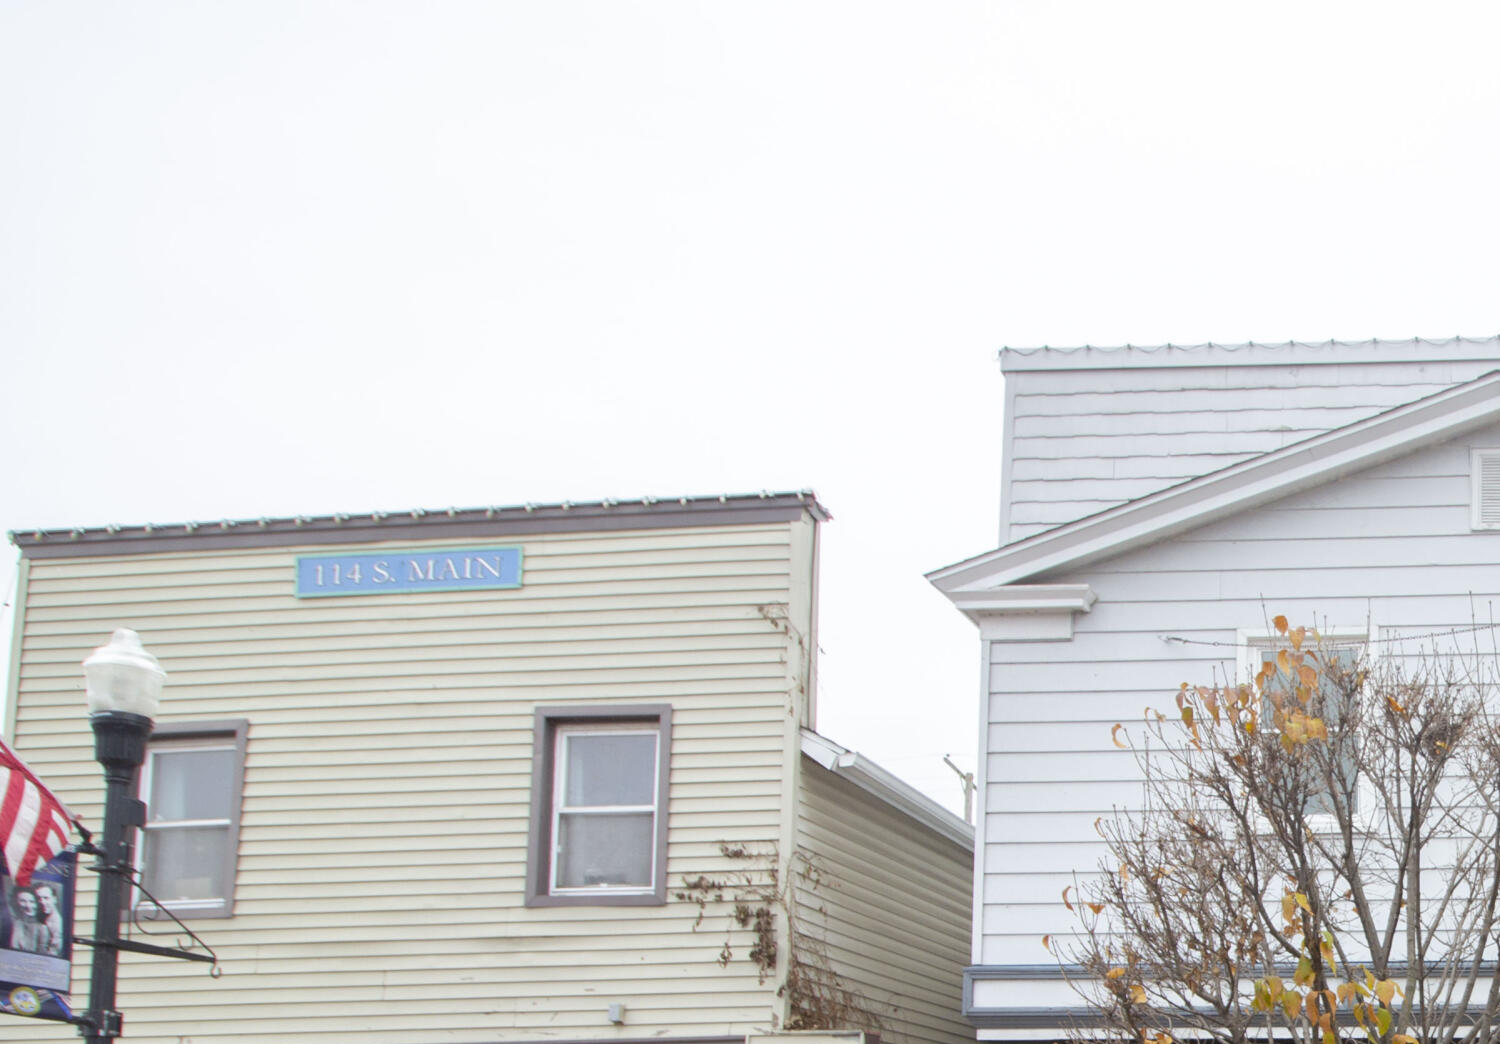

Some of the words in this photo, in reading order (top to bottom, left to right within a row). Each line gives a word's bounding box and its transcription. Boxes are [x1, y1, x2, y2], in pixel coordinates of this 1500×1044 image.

[314, 563, 363, 586] 114
[371, 560, 396, 584] S.
[408, 555, 500, 582] MAIN
